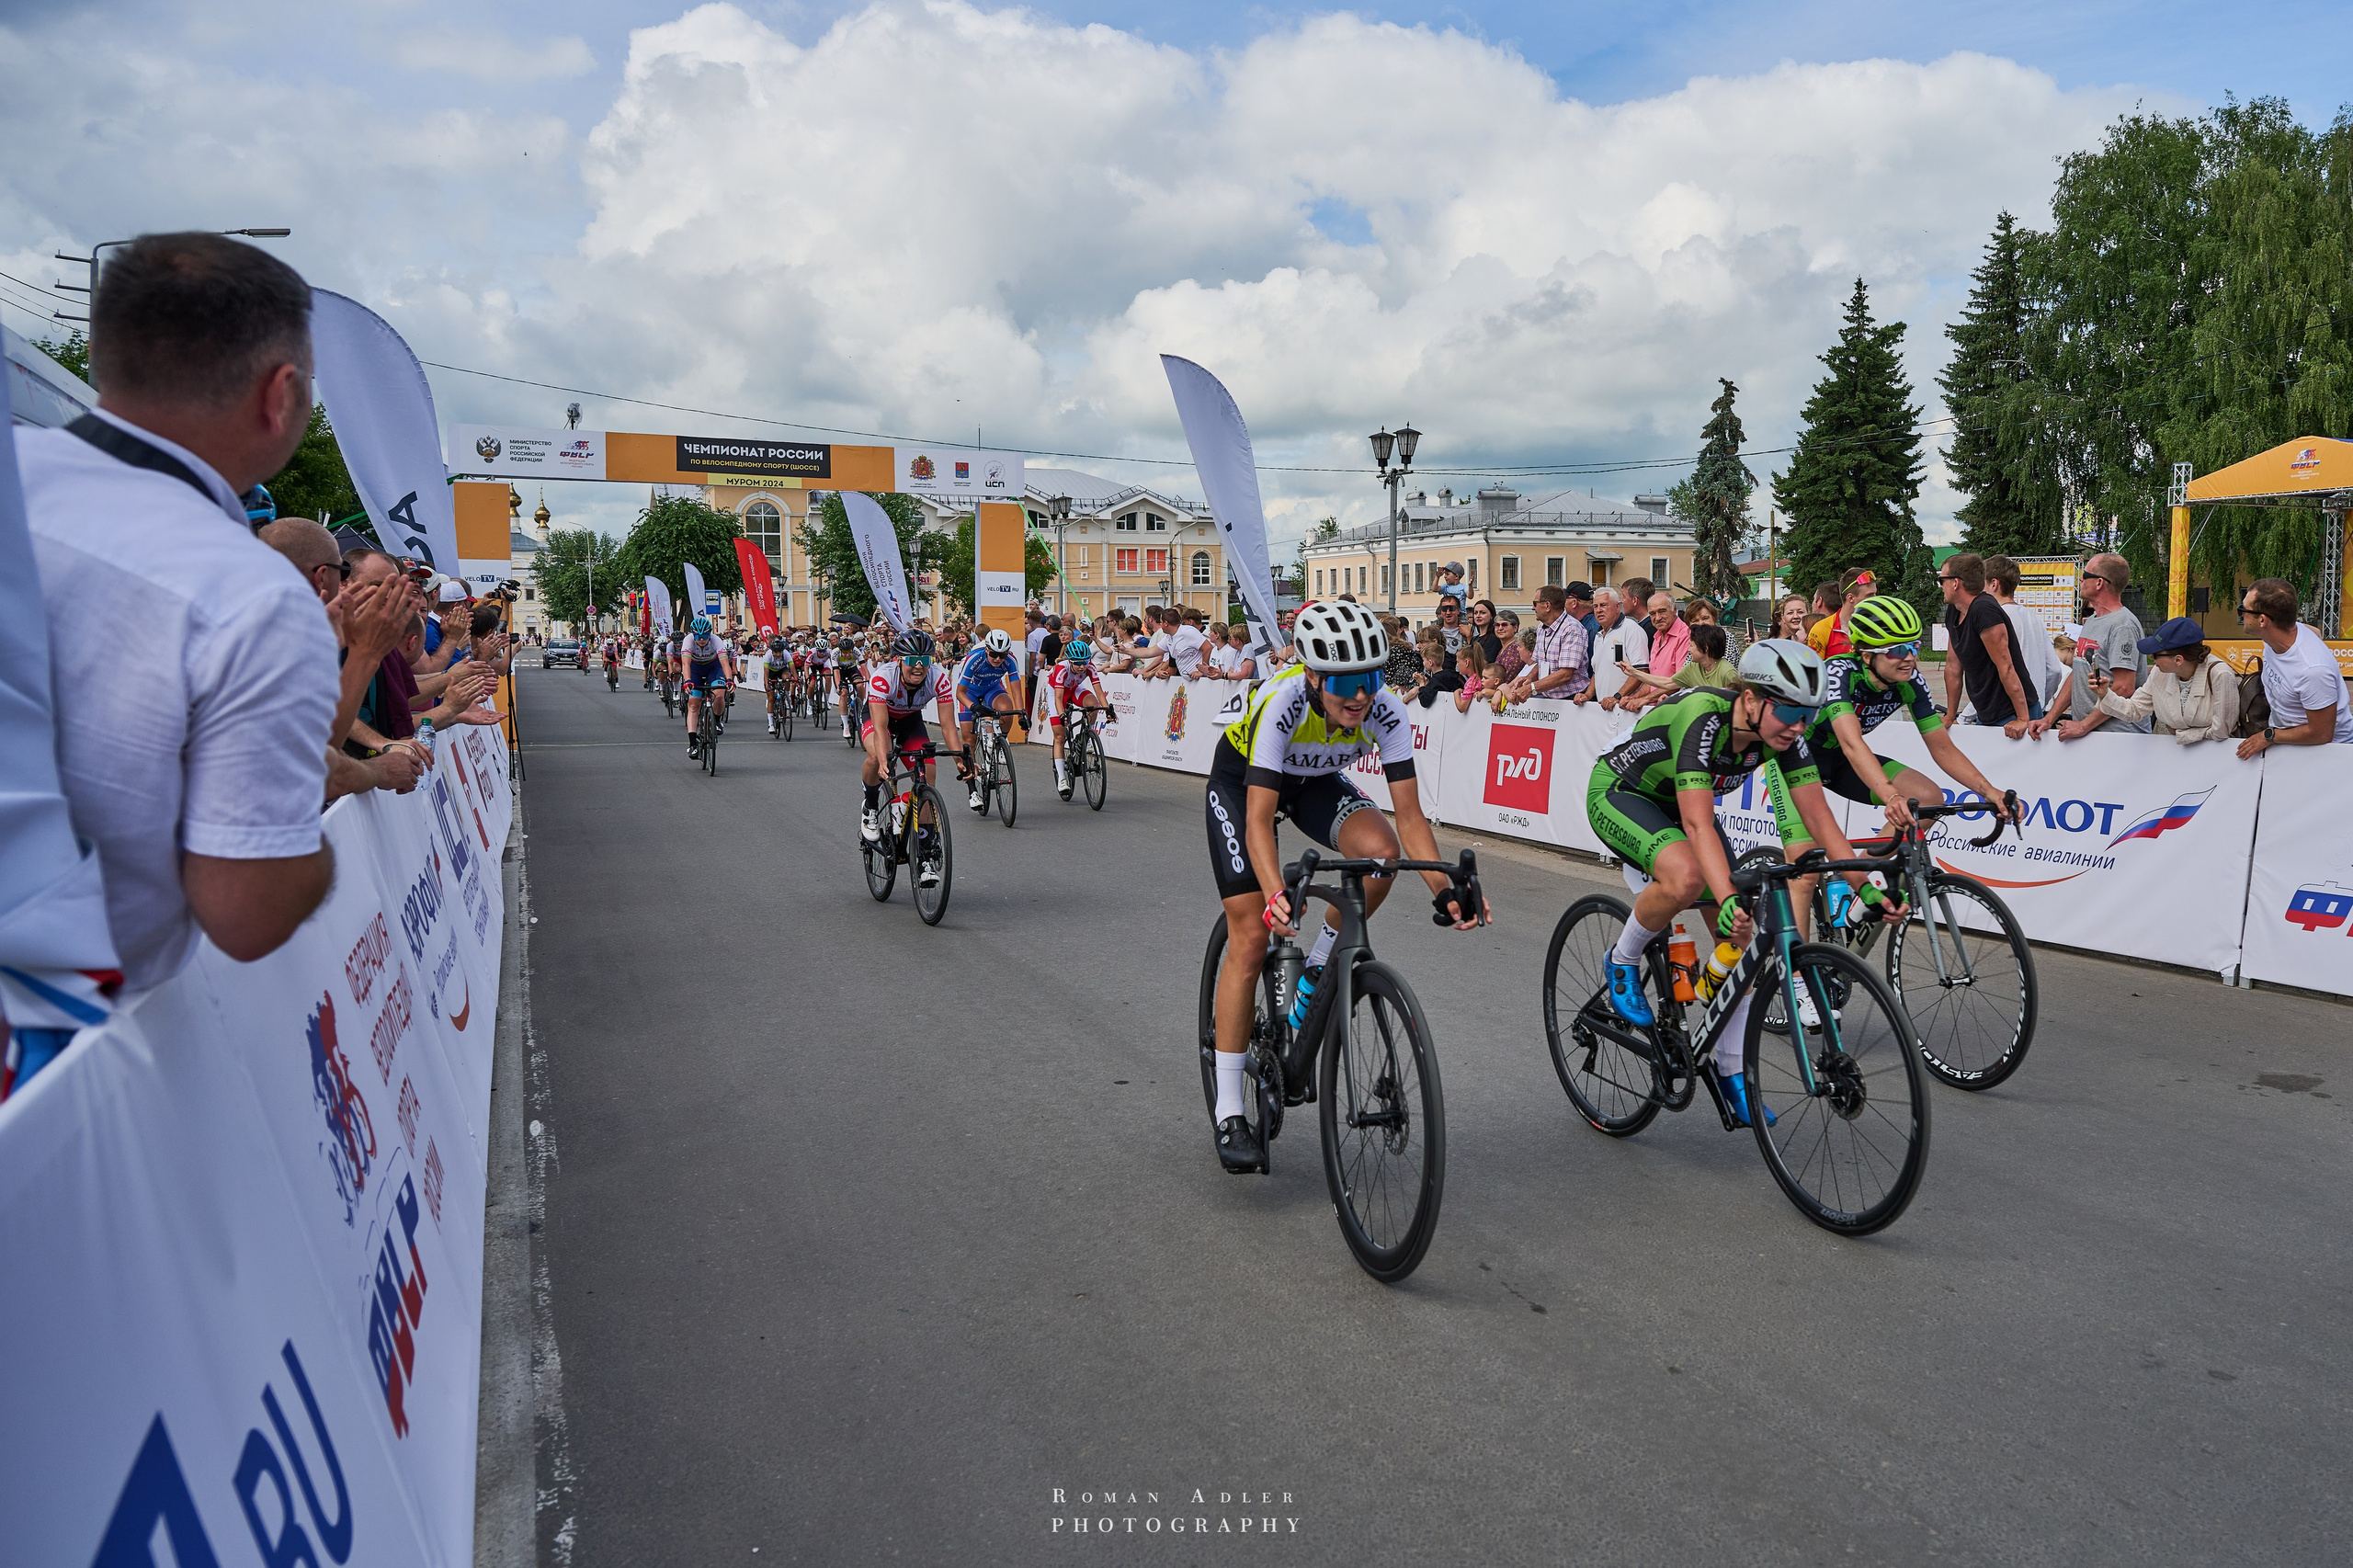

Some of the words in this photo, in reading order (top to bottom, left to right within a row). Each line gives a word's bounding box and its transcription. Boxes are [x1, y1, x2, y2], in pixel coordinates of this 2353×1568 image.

[683, 443, 766, 458] ЧЕМПИОНАТ
[767, 449, 824, 460] РОССИИ
[701, 460, 762, 469] ВЕЛОСИПЕДНОМУ
[726, 478, 761, 486] МУРОМ
[884, 561, 893, 586] РОССИИ
[2333, 648, 2353, 657] ОСС
[1531, 710, 1560, 722] СПОНСОР
[1698, 714, 1722, 767] MICHE
[1498, 812, 1509, 823] ОАО
[1729, 815, 1781, 837] ПОДГОТОВ
[1588, 803, 1642, 855] ST.PETERSBURG
[1726, 836, 1759, 854] ОССИИ
[2024, 846, 2116, 870] авиалинии
[401, 847, 442, 971] АЭРОФ
[344, 911, 392, 1009] ФЕДЕРАЦИЯ
[1690, 935, 1760, 1057] SCOTT
